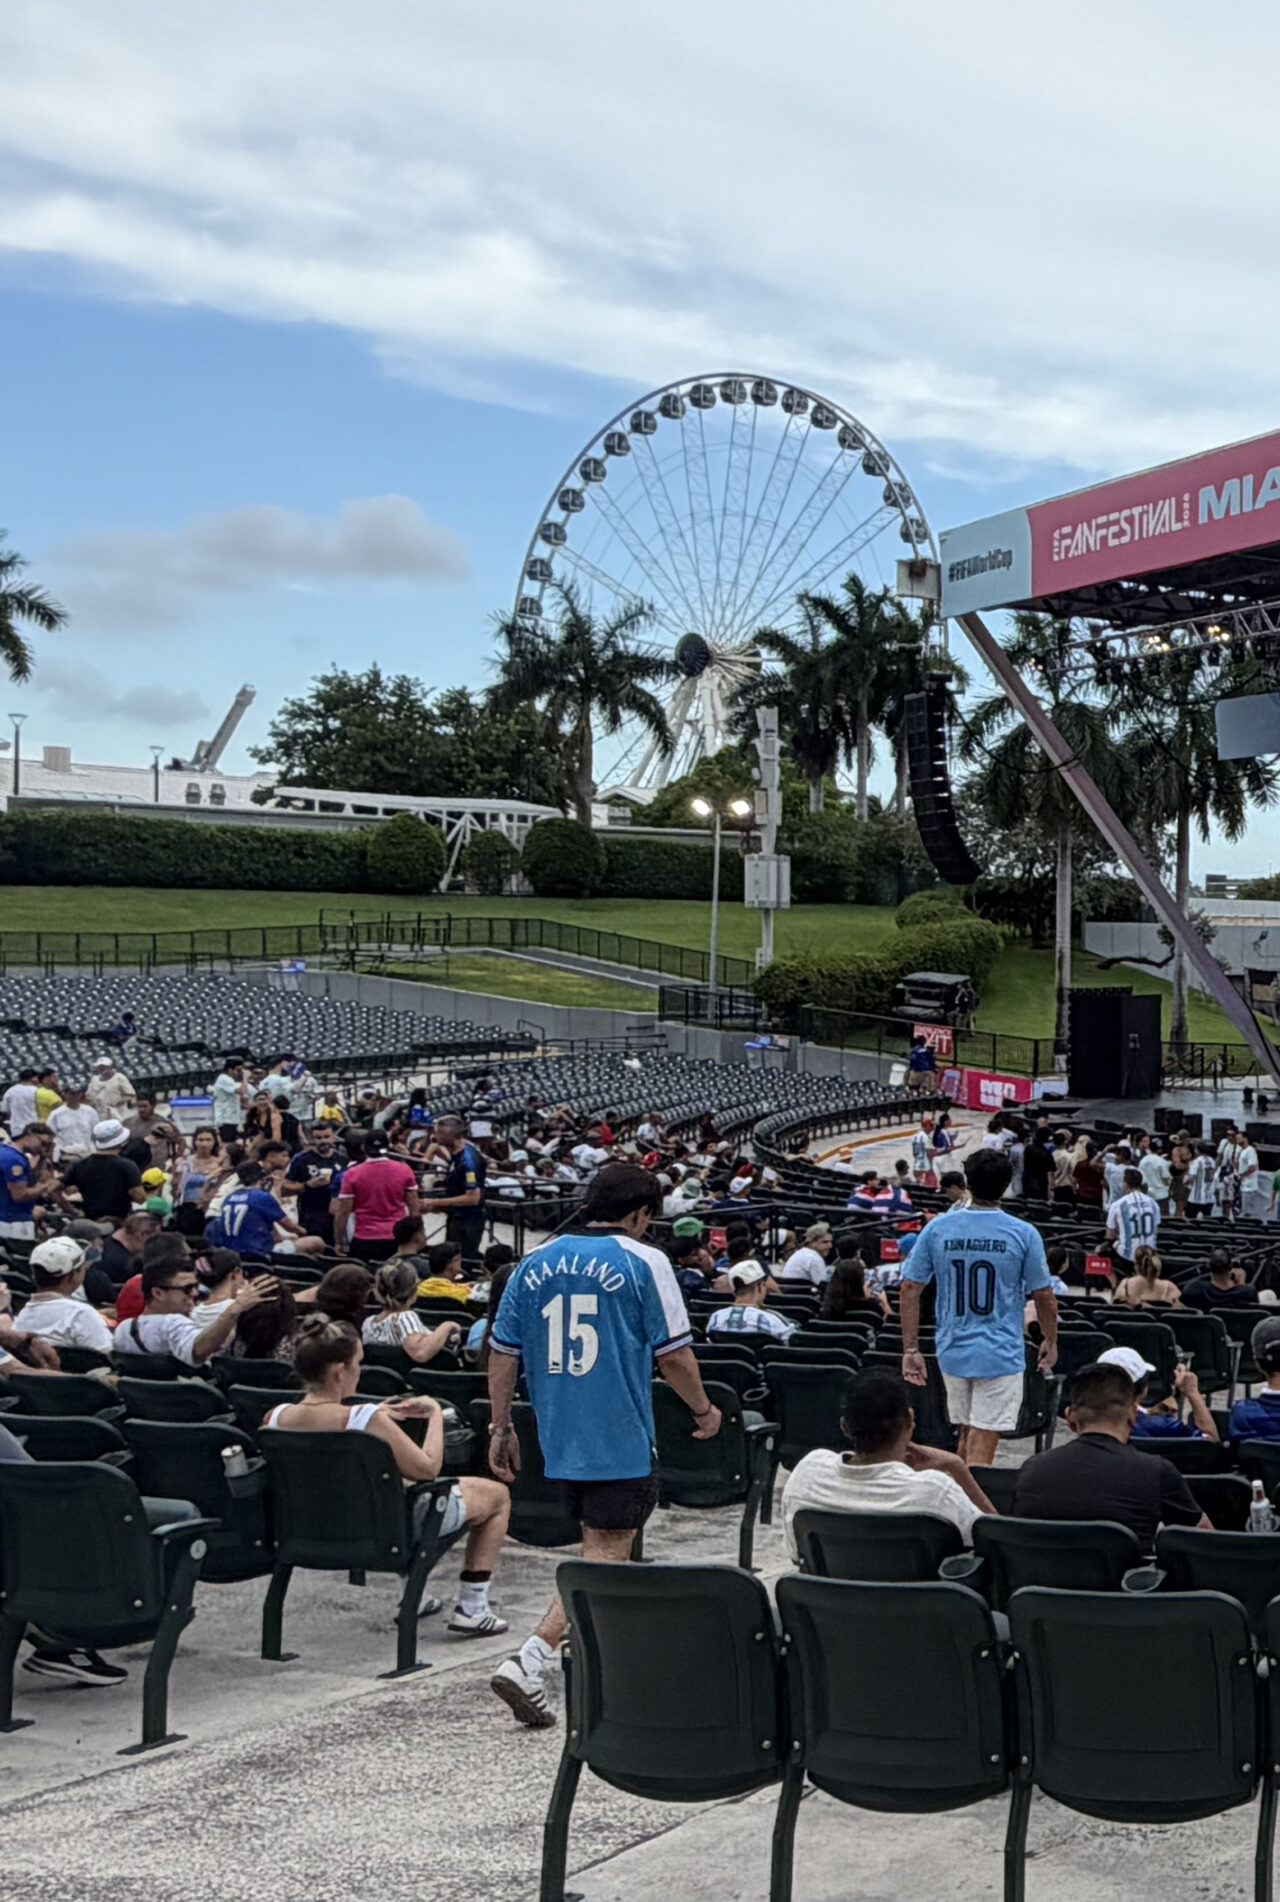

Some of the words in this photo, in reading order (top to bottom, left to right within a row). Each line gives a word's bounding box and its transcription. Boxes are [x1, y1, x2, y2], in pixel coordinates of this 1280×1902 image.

[223, 1204, 248, 1237] 17
[1130, 1212, 1154, 1238] 10
[524, 1253, 626, 1293] HAALAND
[951, 1258, 996, 1317] 10
[541, 1293, 599, 1377] 15
